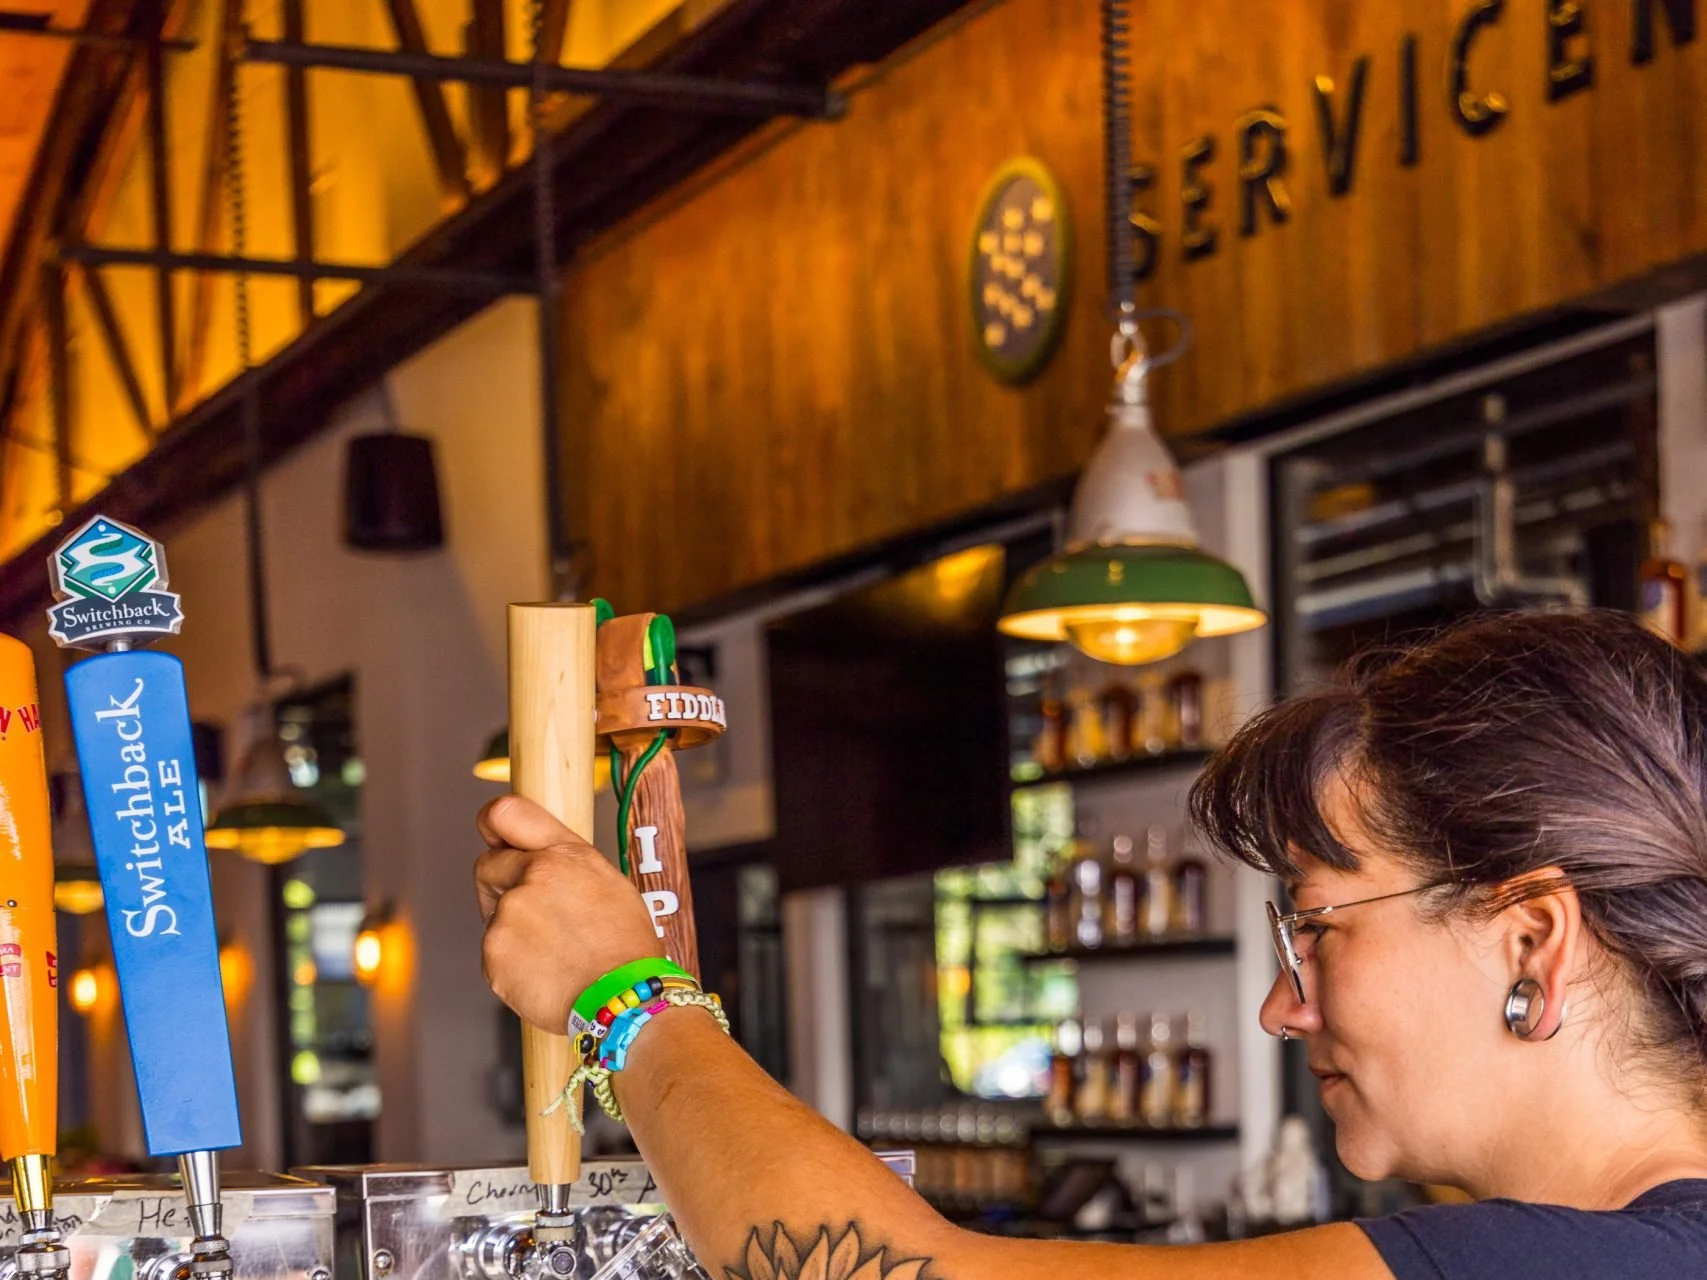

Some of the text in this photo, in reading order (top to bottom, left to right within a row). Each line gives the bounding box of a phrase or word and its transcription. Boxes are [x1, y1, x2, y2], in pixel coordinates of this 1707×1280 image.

[63, 598, 171, 629] Switchback
[86, 619, 132, 633] BREWING
[95, 677, 182, 938] Switchback
[158, 758, 191, 850] ALE
[634, 825, 680, 960] IP
